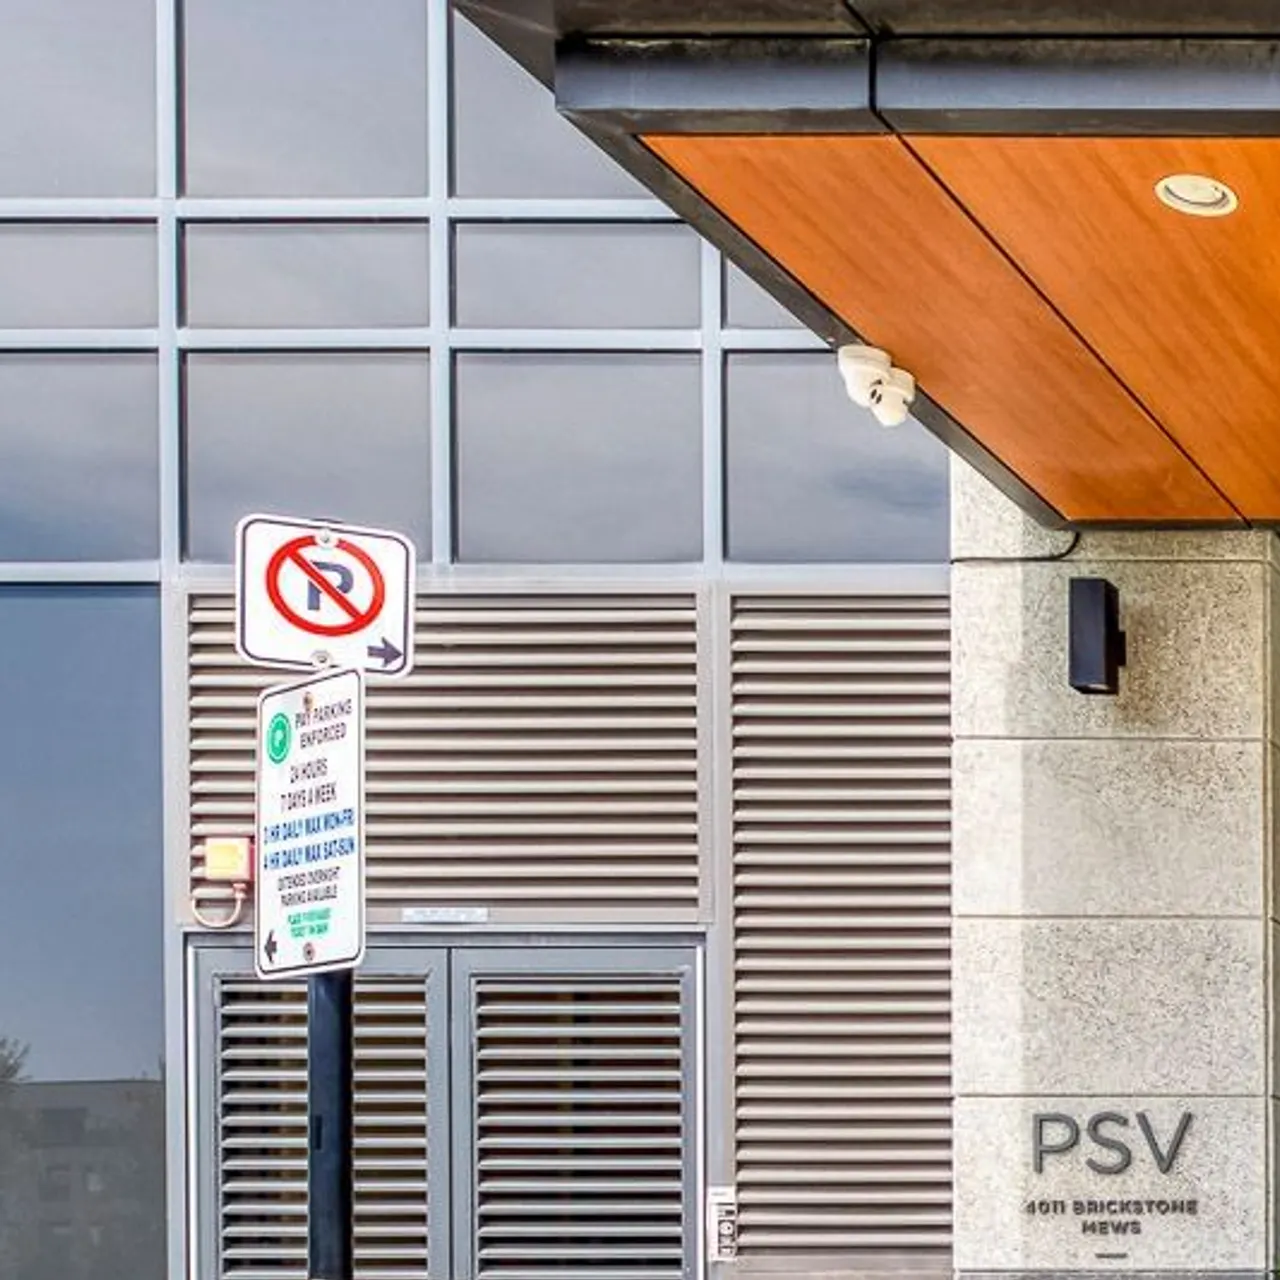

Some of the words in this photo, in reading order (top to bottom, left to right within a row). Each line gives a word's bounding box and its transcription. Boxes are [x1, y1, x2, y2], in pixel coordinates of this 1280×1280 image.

[313, 699, 351, 723] PARKING
[301, 723, 346, 749] ENFORCED
[300, 758, 327, 780] HOURS
[288, 789, 306, 811] DAYS
[315, 782, 336, 804] WEEK
[269, 825, 279, 843] HR
[282, 819, 303, 840] DAILY
[305, 816, 321, 836] MAX
[269, 851, 279, 868] HR
[282, 847, 303, 867] DAILY
[305, 844, 321, 862] MAX
[323, 837, 355, 860] SAT-SUN
[1033, 1111, 1194, 1175] PSV
[1026, 1200, 1066, 1215] 4011
[1072, 1200, 1199, 1215] BRICKSTONE
[1081, 1220, 1142, 1235] MEWS
